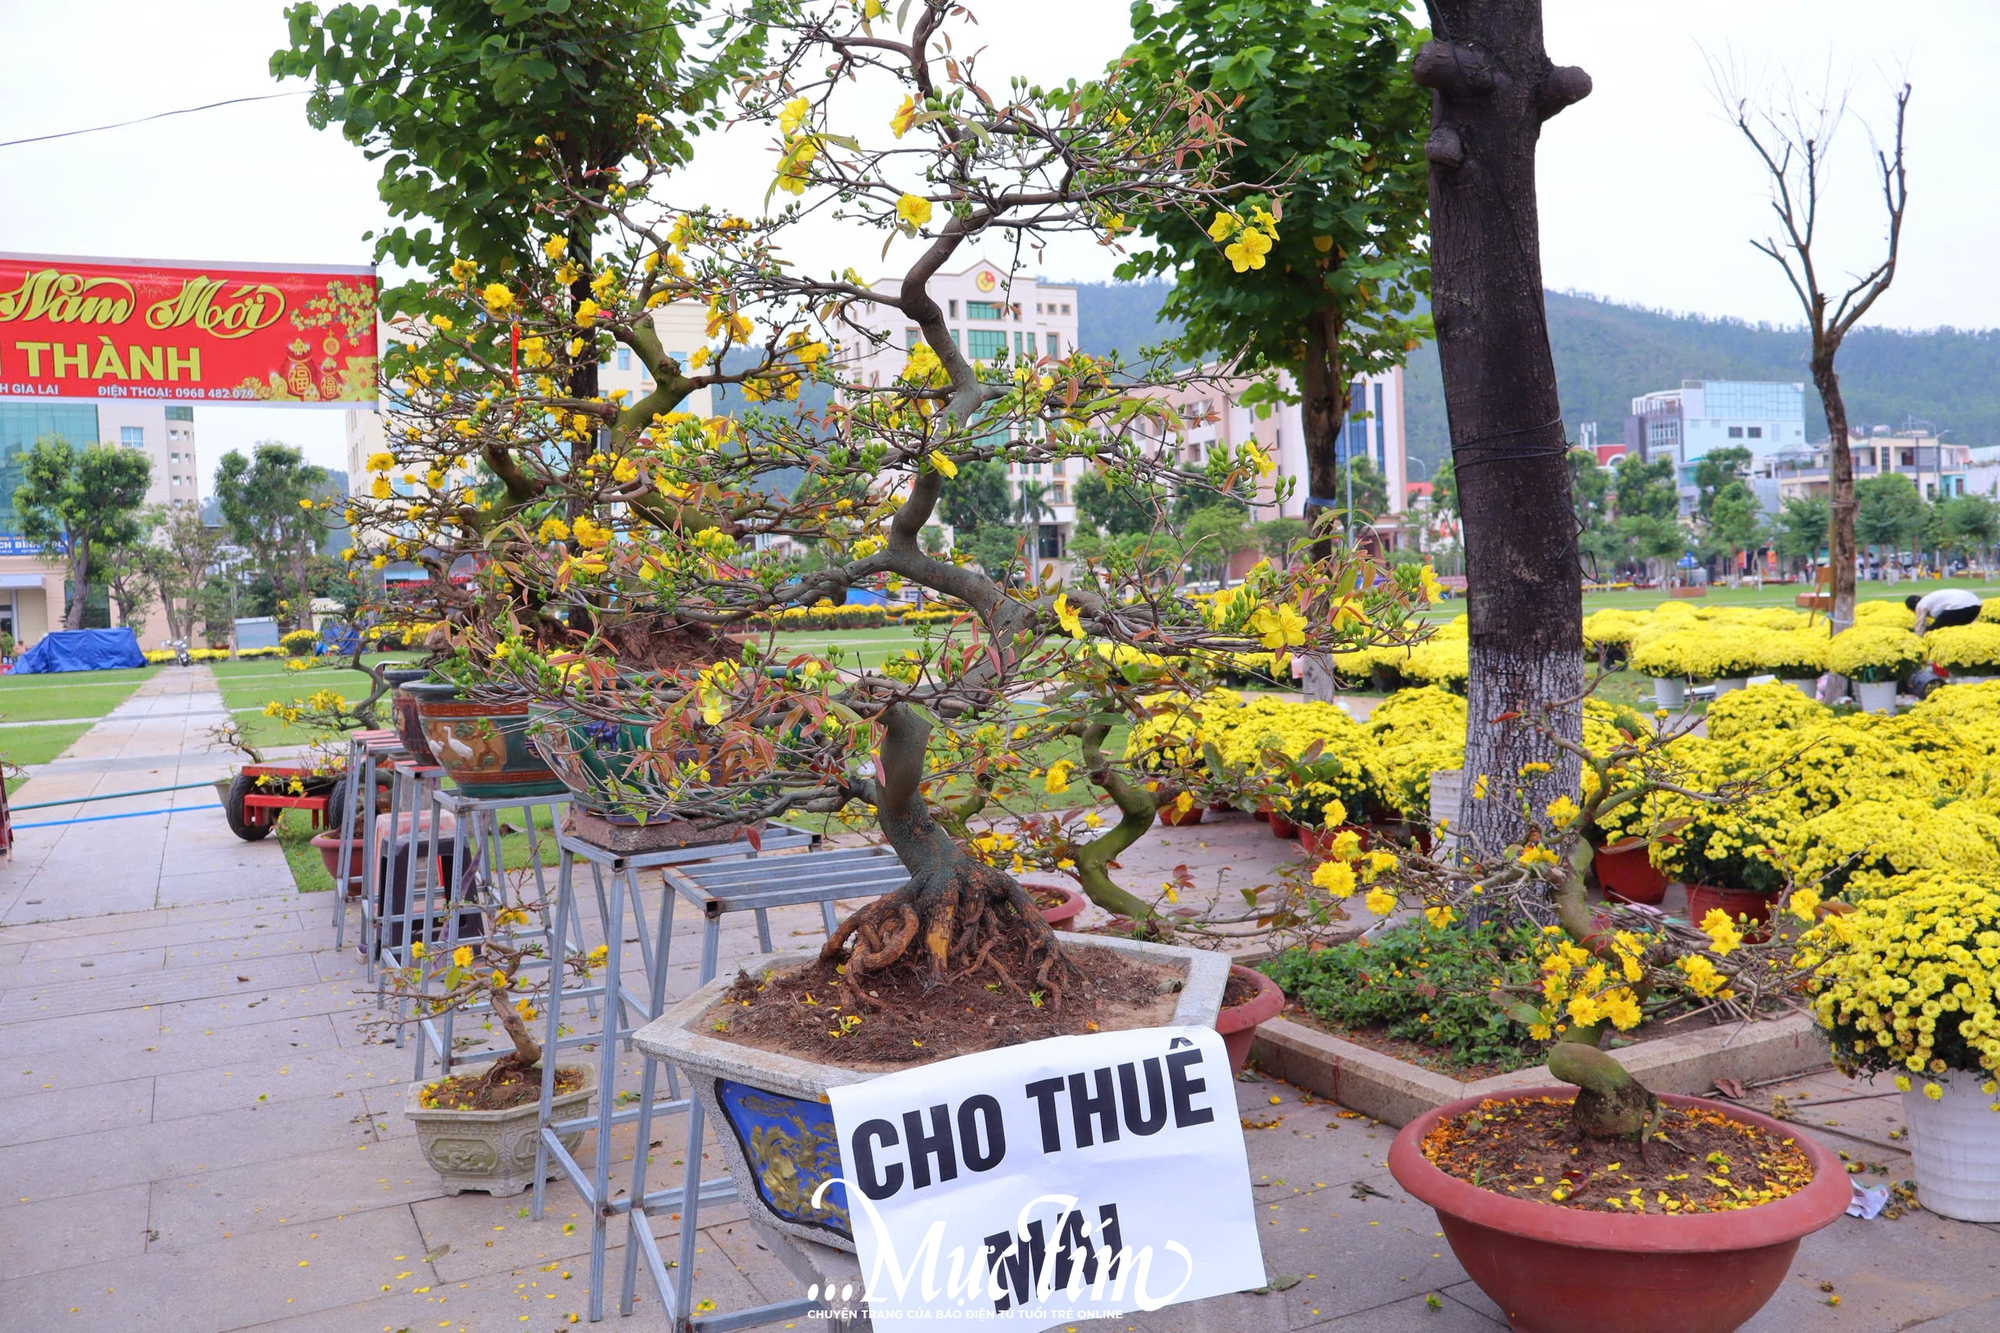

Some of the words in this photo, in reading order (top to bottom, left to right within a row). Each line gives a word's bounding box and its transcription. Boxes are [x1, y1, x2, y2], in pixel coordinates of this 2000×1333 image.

[145, 275, 286, 339] Mới
[15, 335, 201, 382] THÀNH
[12, 384, 34, 394] GIA
[38, 384, 58, 395] LAI
[98, 384, 127, 399] ĐIỆN
[130, 386, 172, 400] THOẠI:
[175, 388, 204, 398] 0968
[208, 388, 229, 399] 482
[852, 1094, 1006, 1200] CHO
[1025, 1037, 1215, 1154] THUÊ
